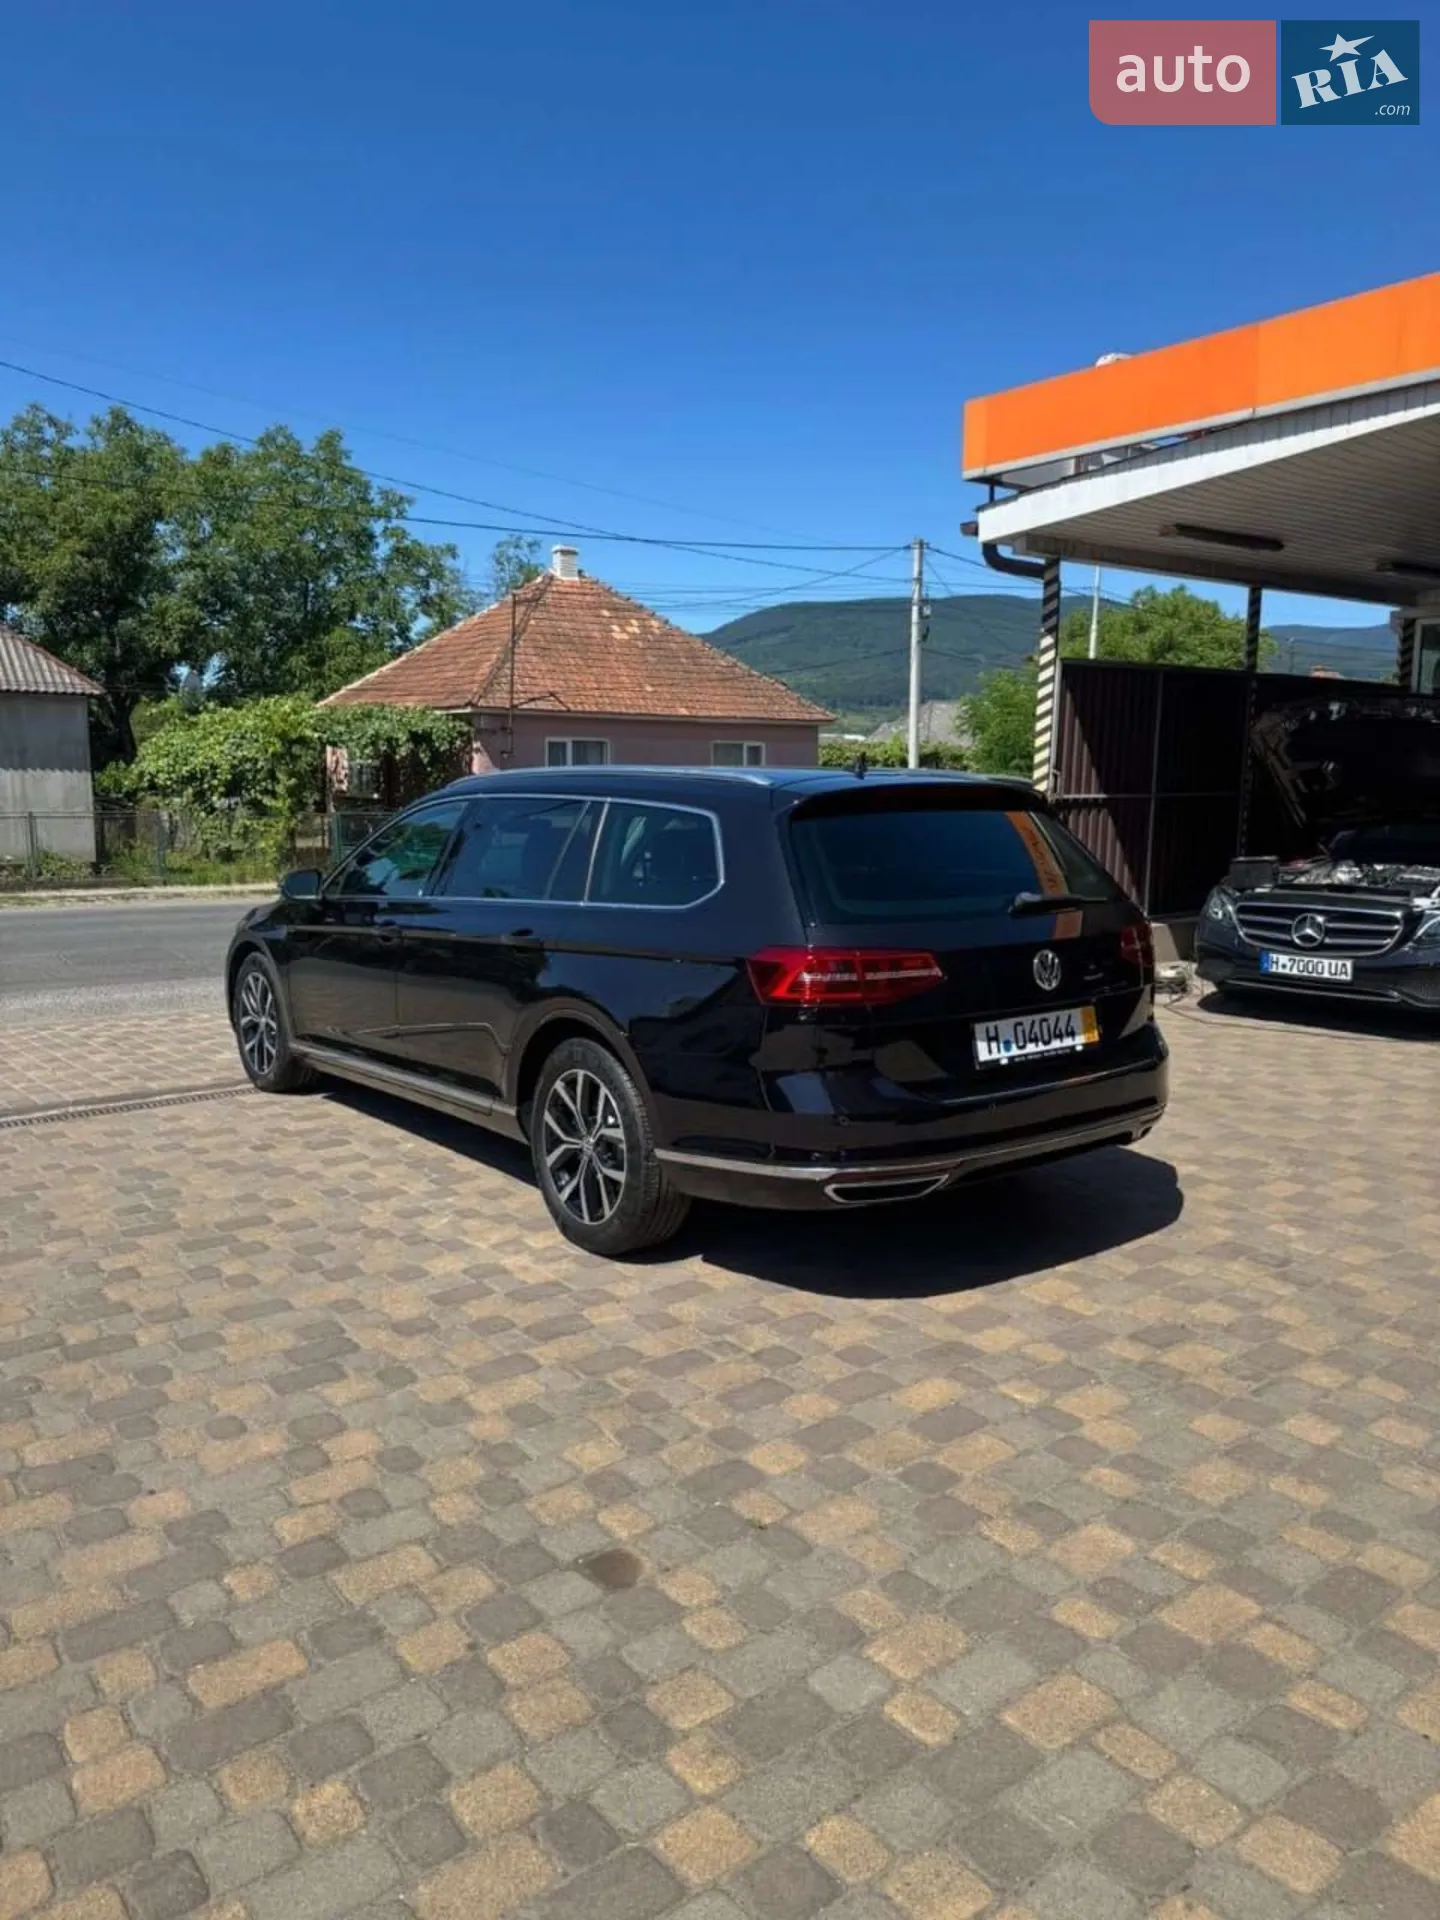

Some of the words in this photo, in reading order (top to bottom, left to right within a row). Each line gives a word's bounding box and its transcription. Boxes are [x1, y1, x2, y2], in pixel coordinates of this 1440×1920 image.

[1270, 954, 1280, 972] H
[1288, 958, 1325, 976] 7000
[1328, 960, 1349, 978] UA
[985, 1023, 1001, 1056] H
[1013, 1013, 1077, 1050] 04044
